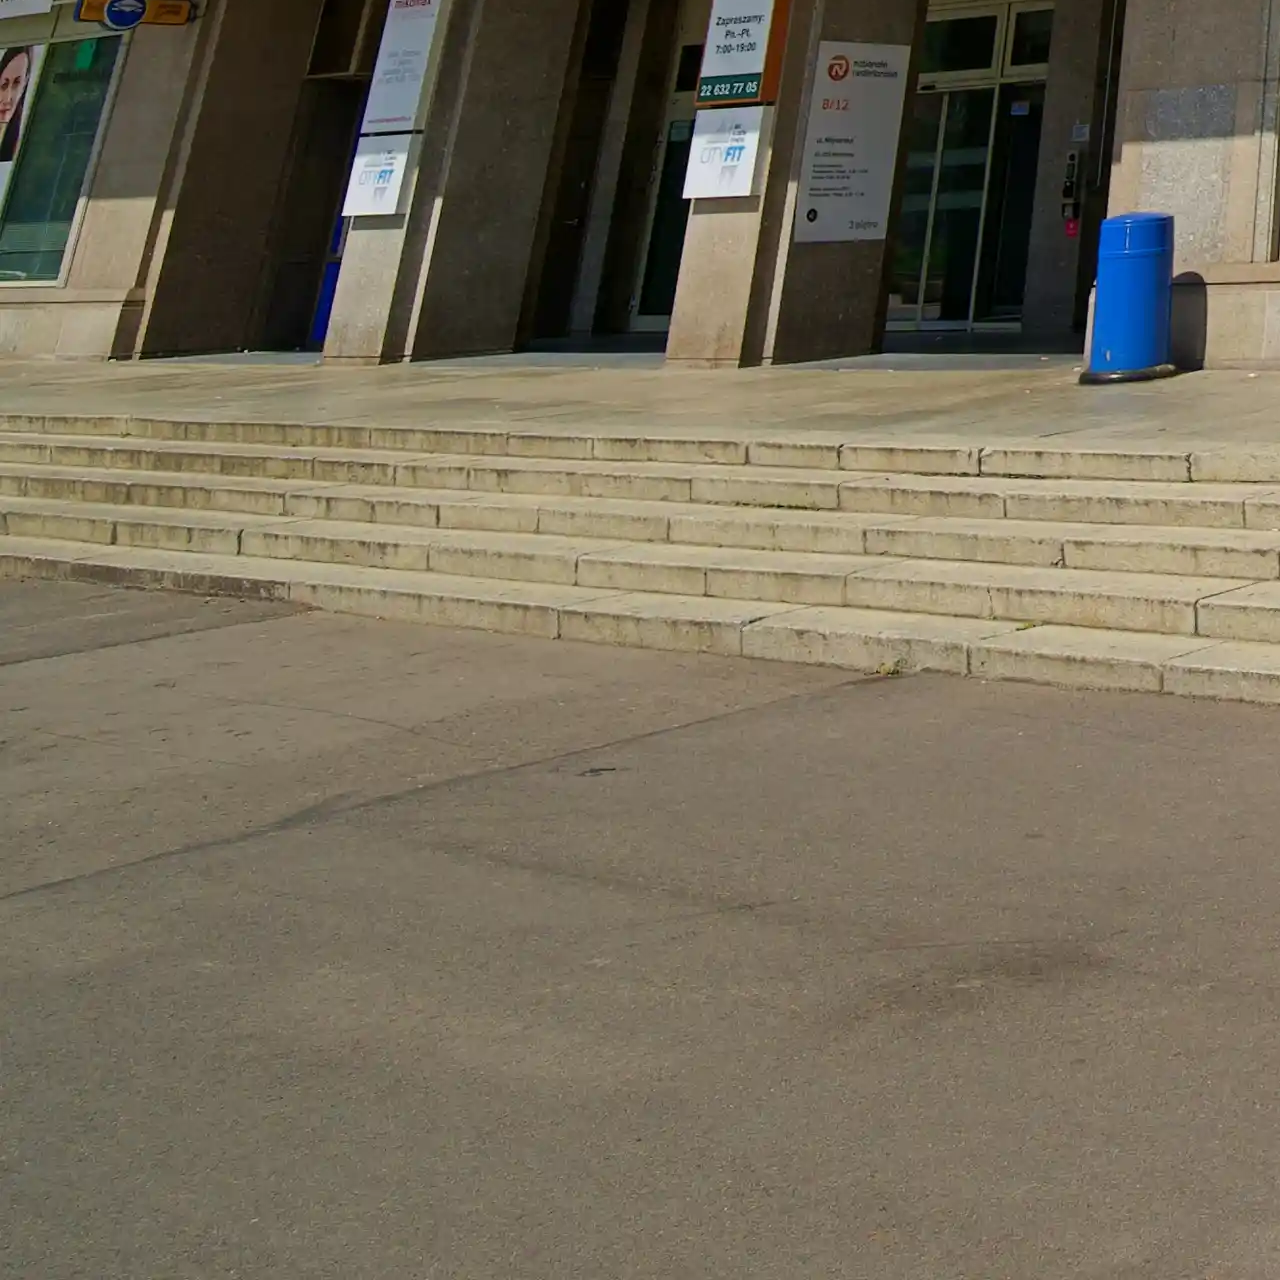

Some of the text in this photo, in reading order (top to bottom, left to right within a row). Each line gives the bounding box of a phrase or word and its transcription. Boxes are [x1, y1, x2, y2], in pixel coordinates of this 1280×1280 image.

[700, 81, 758, 97] 22 632 77 05
[821, 98, 849, 111] 8/12
